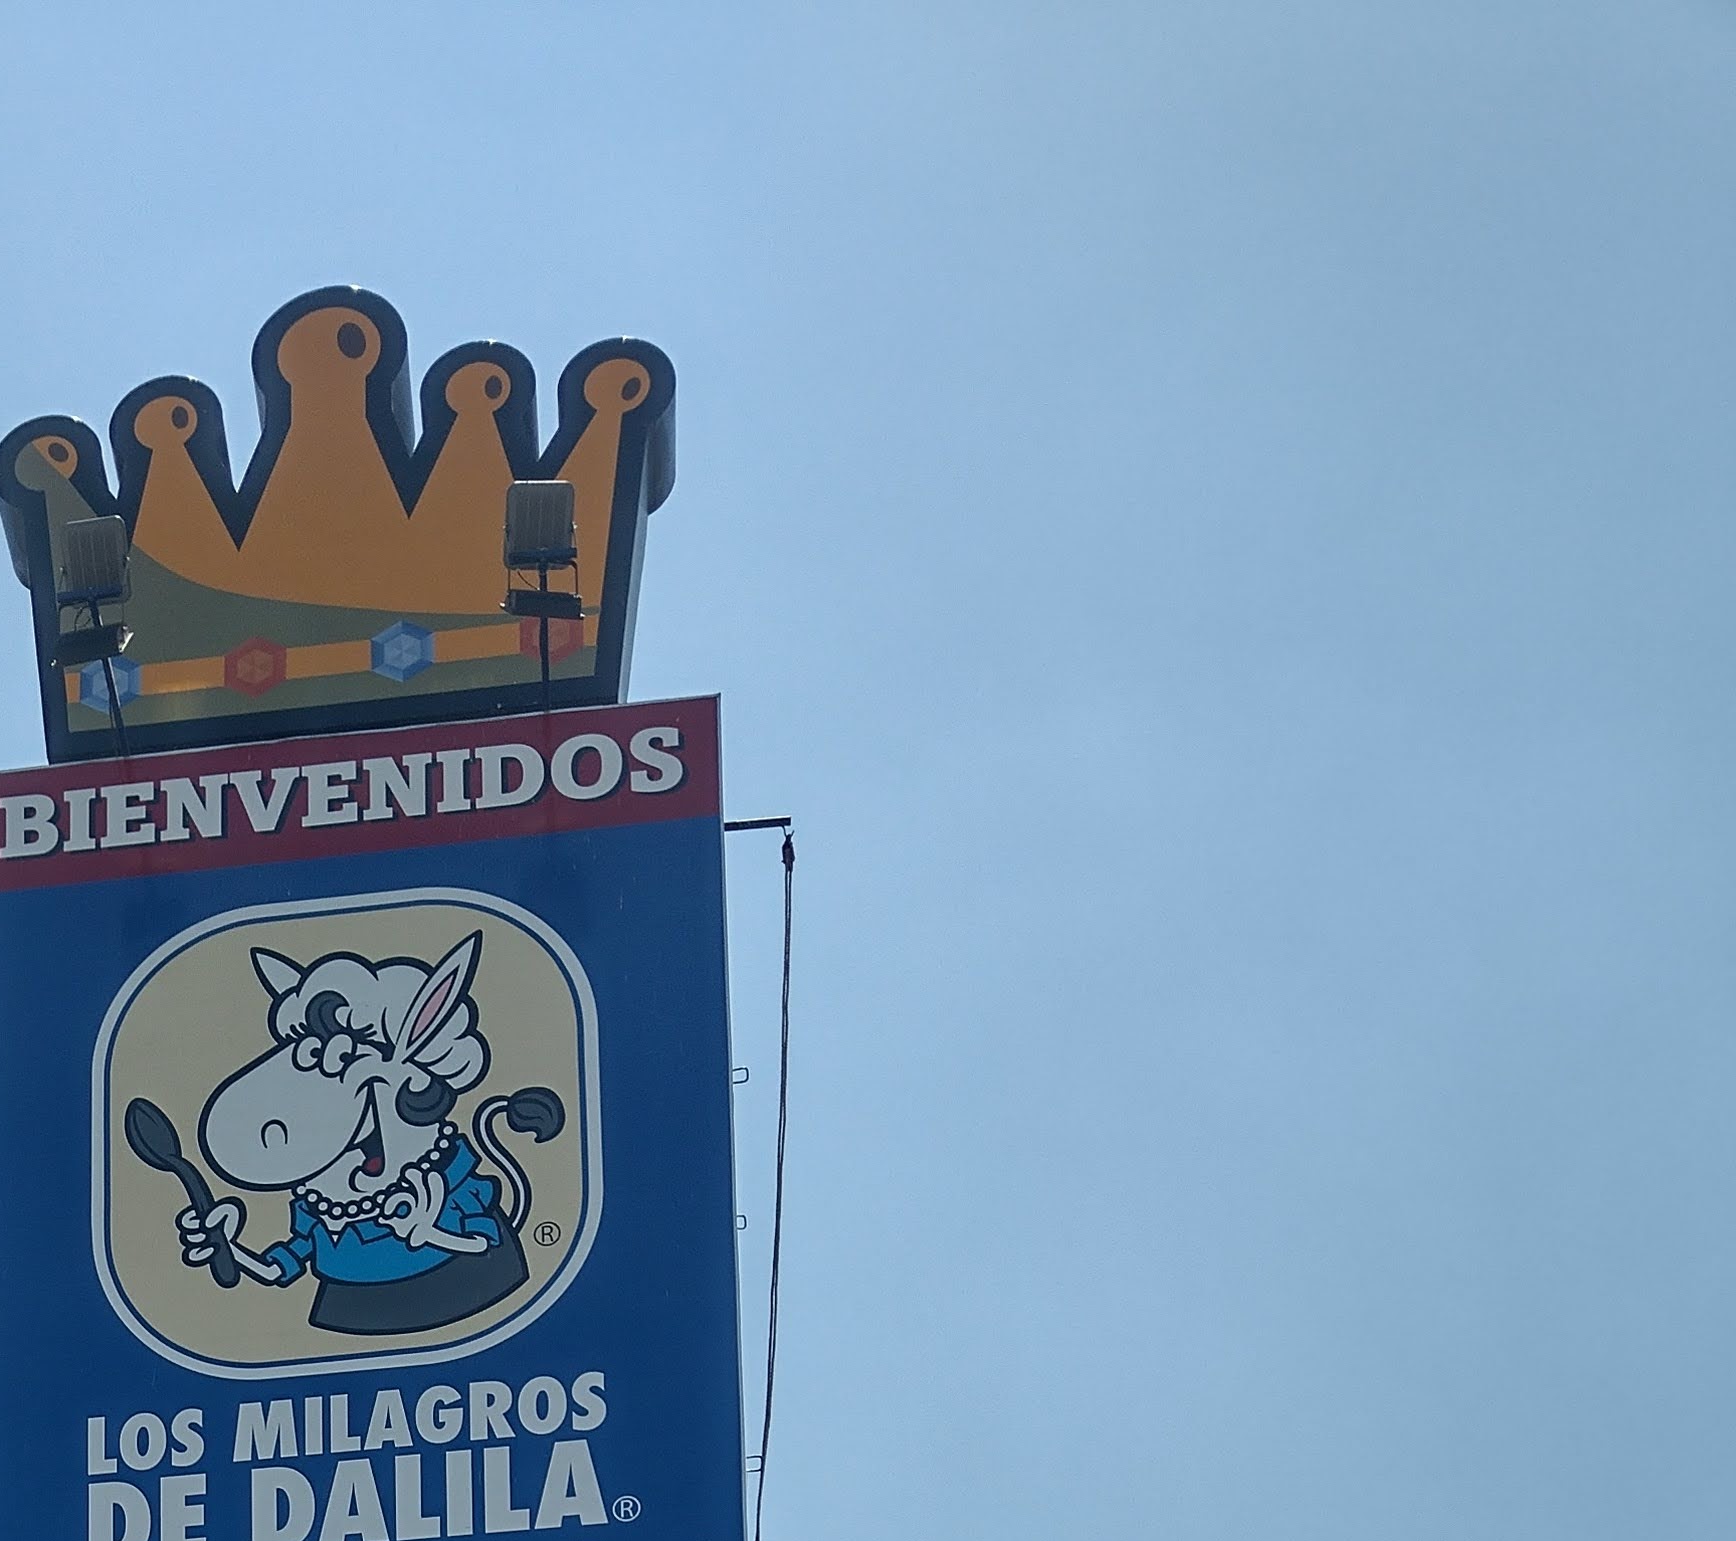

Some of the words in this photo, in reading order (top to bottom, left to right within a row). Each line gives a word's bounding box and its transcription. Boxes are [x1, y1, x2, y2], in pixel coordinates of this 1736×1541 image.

[0, 726, 684, 859] BIENVENIDOS
[87, 1408, 205, 1476] LOS
[232, 1371, 608, 1463] MILAGROS
